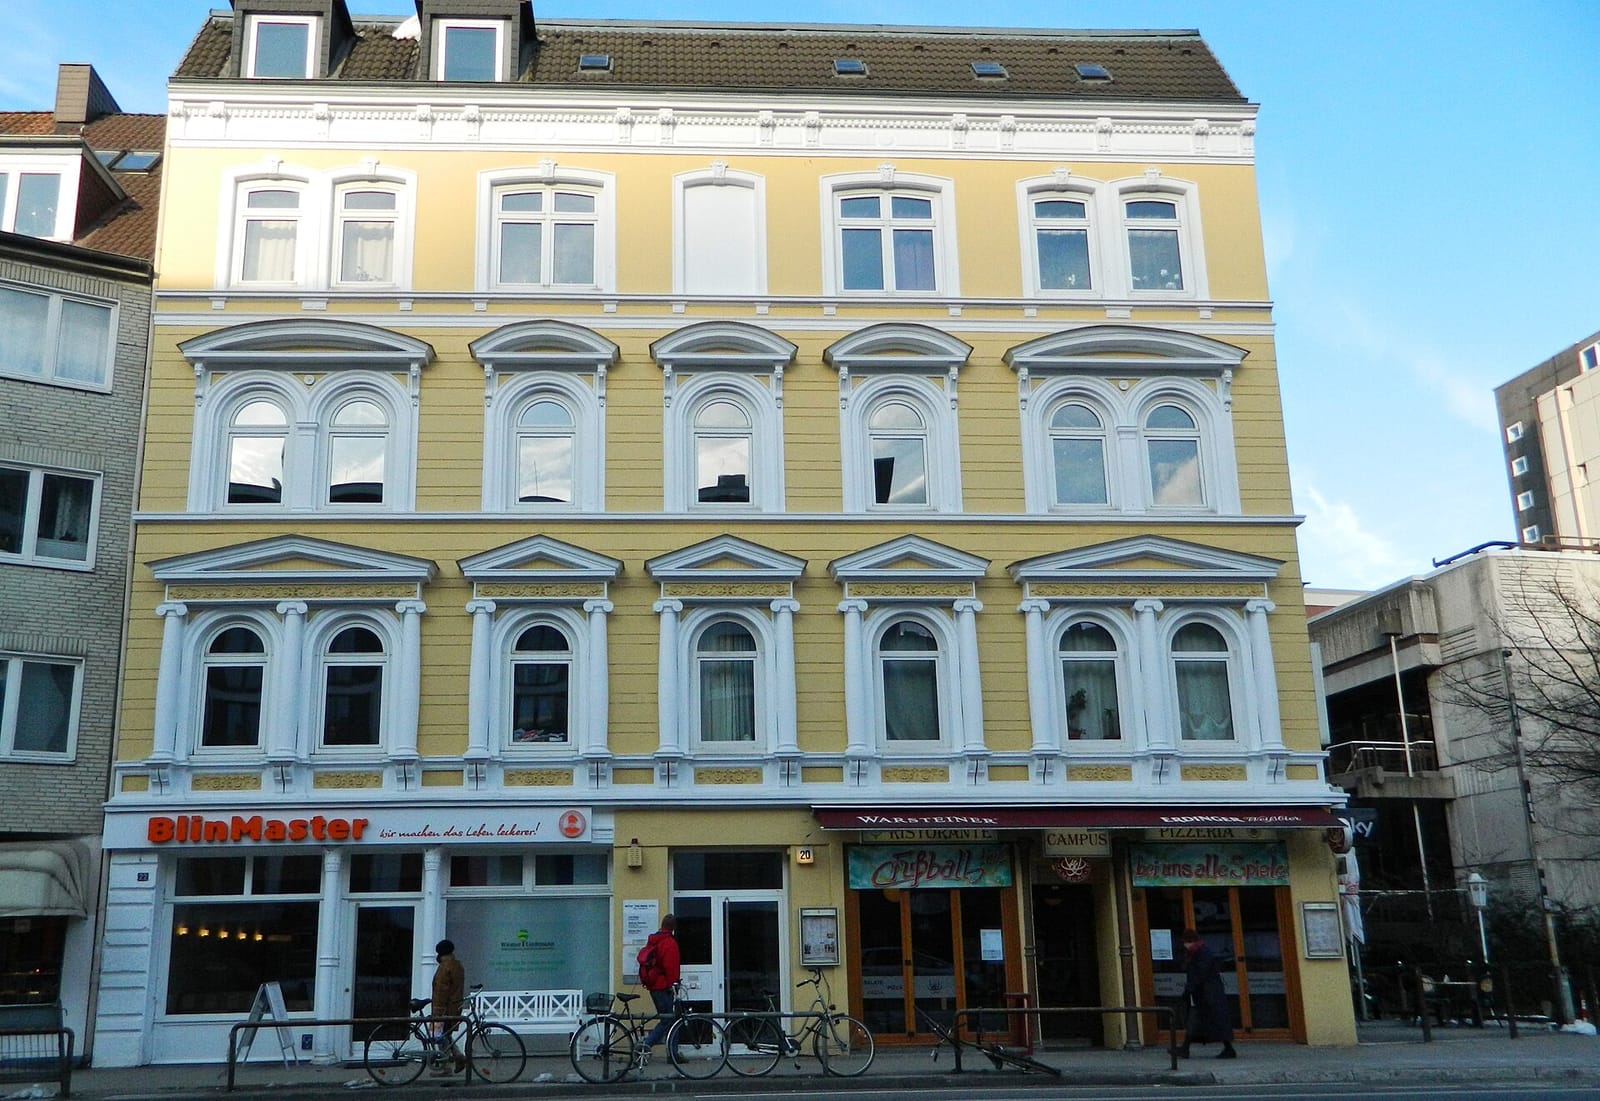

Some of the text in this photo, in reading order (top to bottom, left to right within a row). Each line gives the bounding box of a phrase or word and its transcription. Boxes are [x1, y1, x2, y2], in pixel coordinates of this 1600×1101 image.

[857, 816, 998, 824] WARSTEINER
[148, 815, 368, 843] BlinMaster
[399, 824, 440, 837] machen
[443, 825, 463, 836] das
[466, 823, 494, 837] Leben
[497, 821, 540, 836] leckerer!
[1047, 833, 1107, 846] CAMPUS
[800, 850, 810, 860] 20
[871, 848, 985, 887] Fußball
[1135, 853, 1286, 882] bei uns alle Spiele
